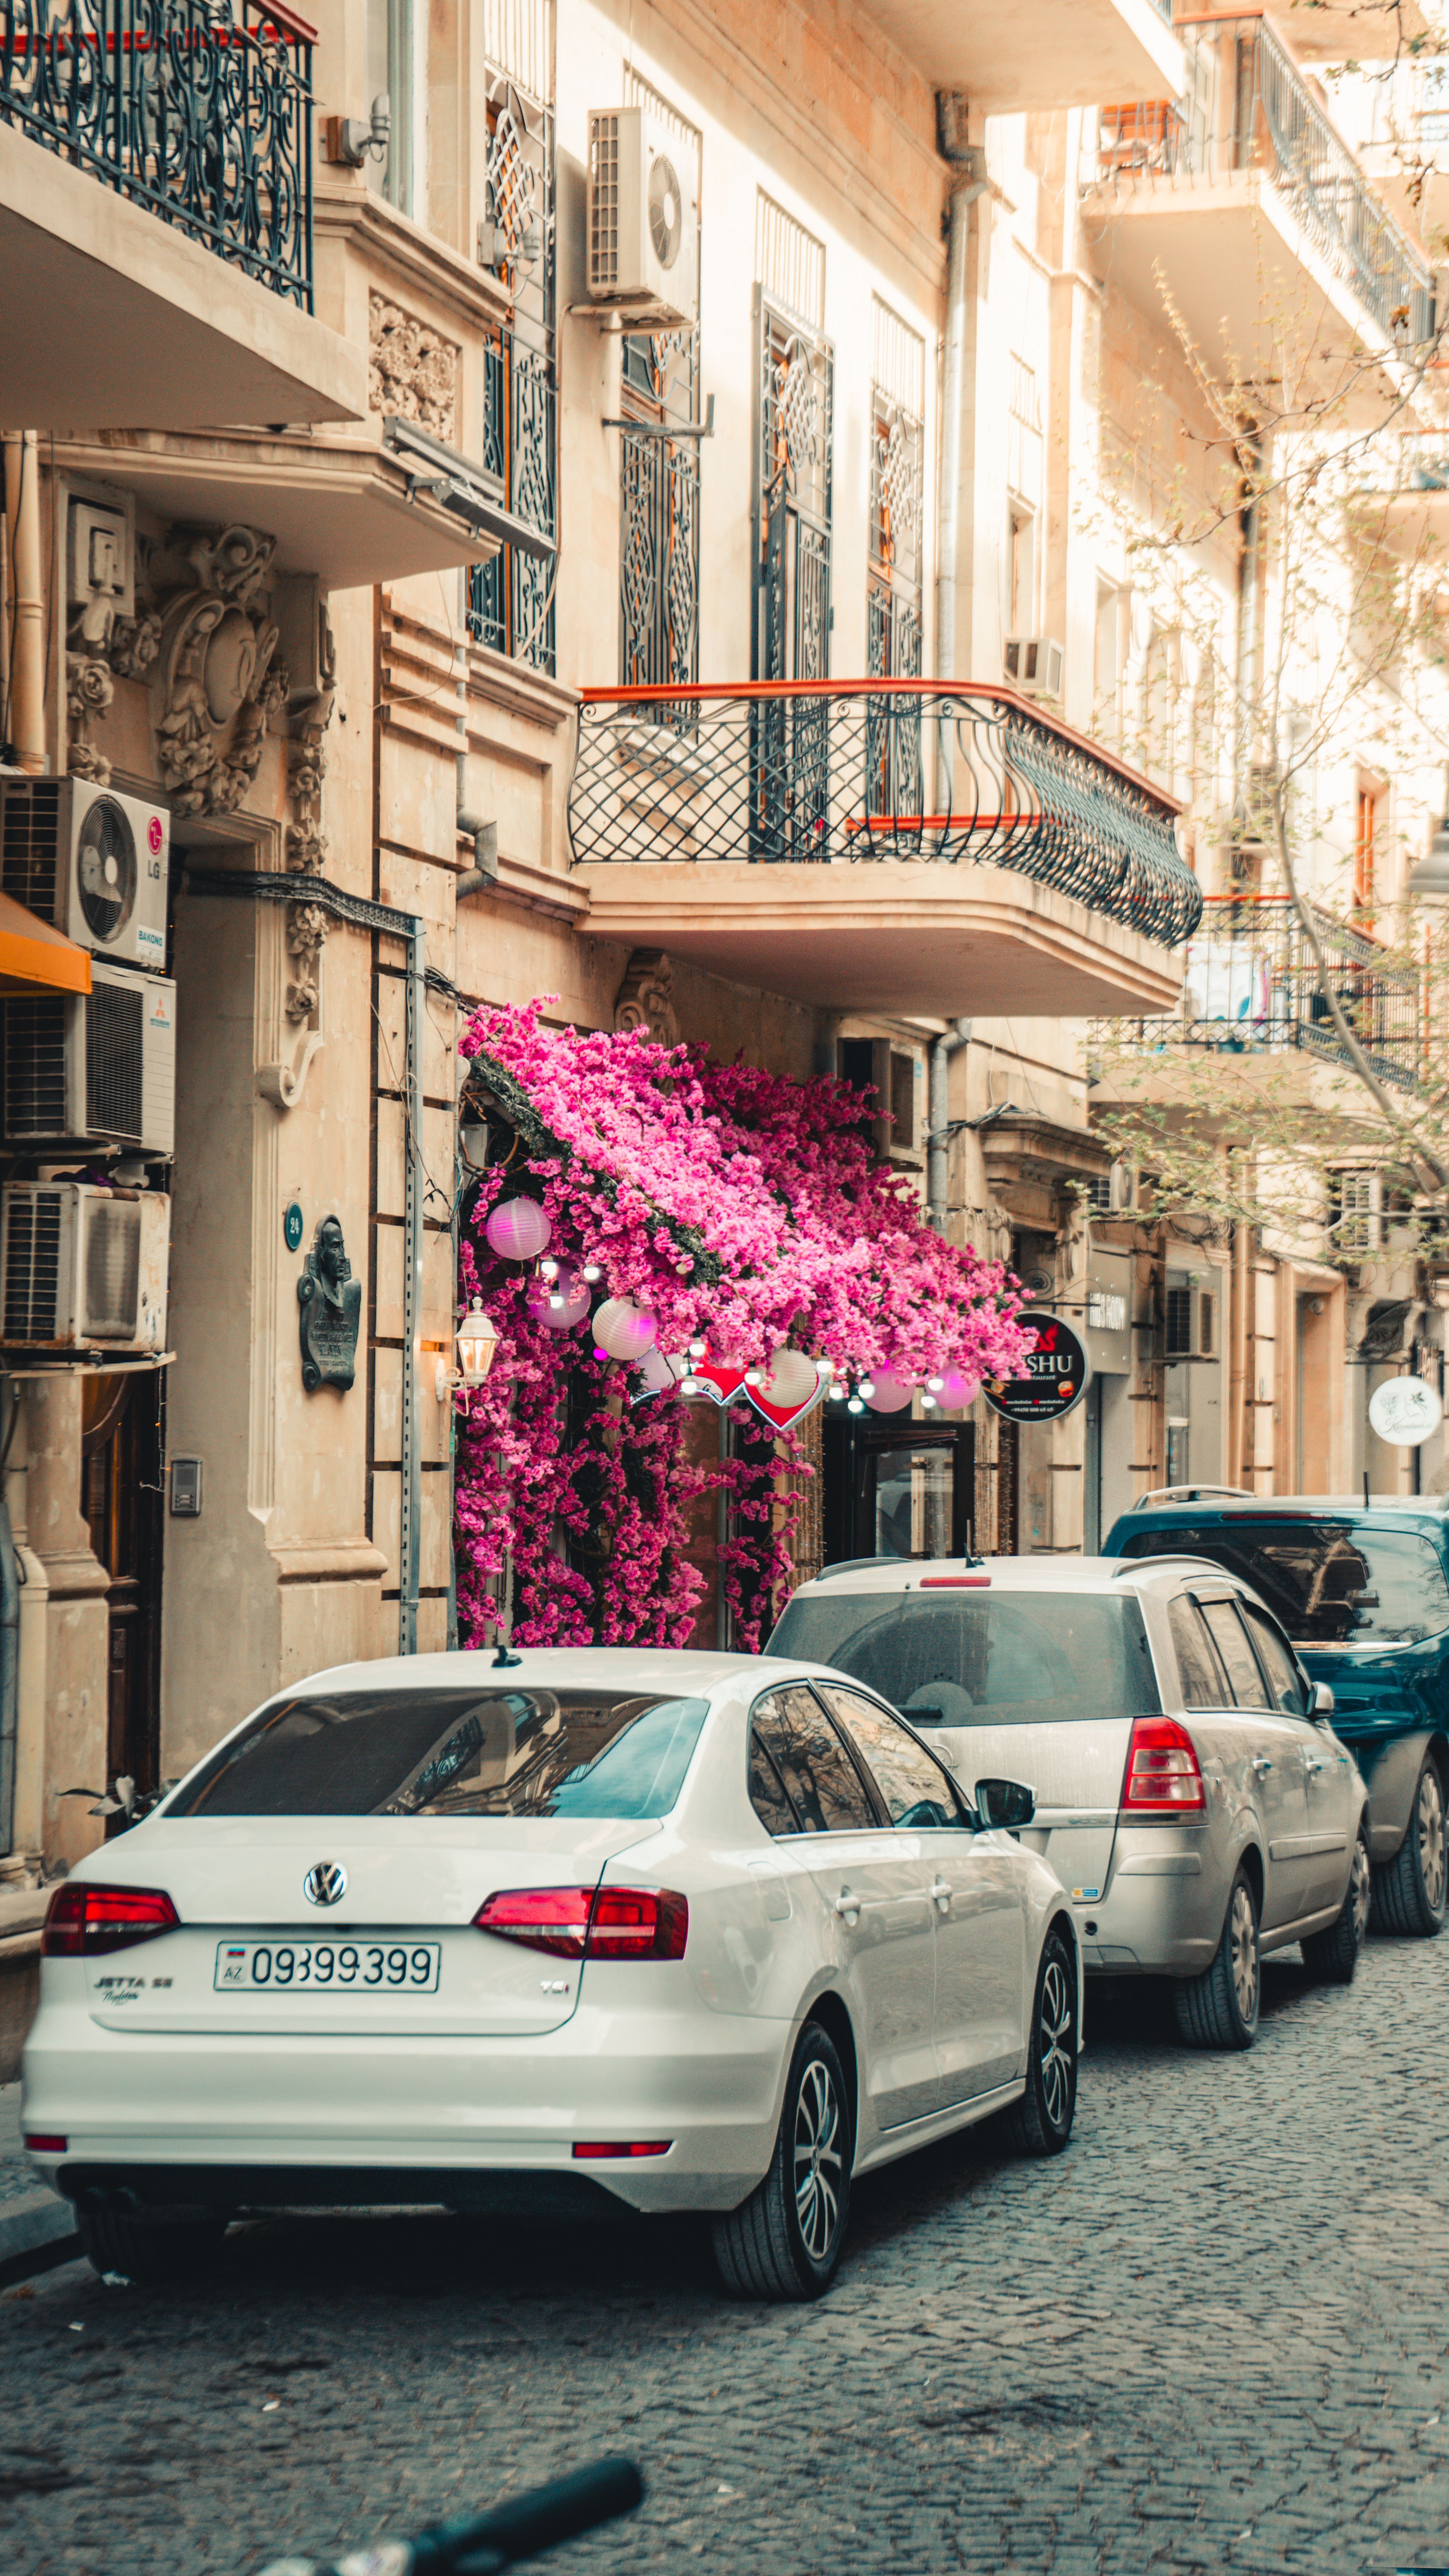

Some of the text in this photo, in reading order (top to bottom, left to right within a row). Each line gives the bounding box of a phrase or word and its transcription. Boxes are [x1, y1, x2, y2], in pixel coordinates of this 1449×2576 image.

[147, 860, 160, 880] LG
[290, 1217, 300, 1234] 24
[1106, 1294, 1124, 1330] ROOM
[224, 1967, 242, 1980] AZ
[94, 1977, 145, 1989] JETTA
